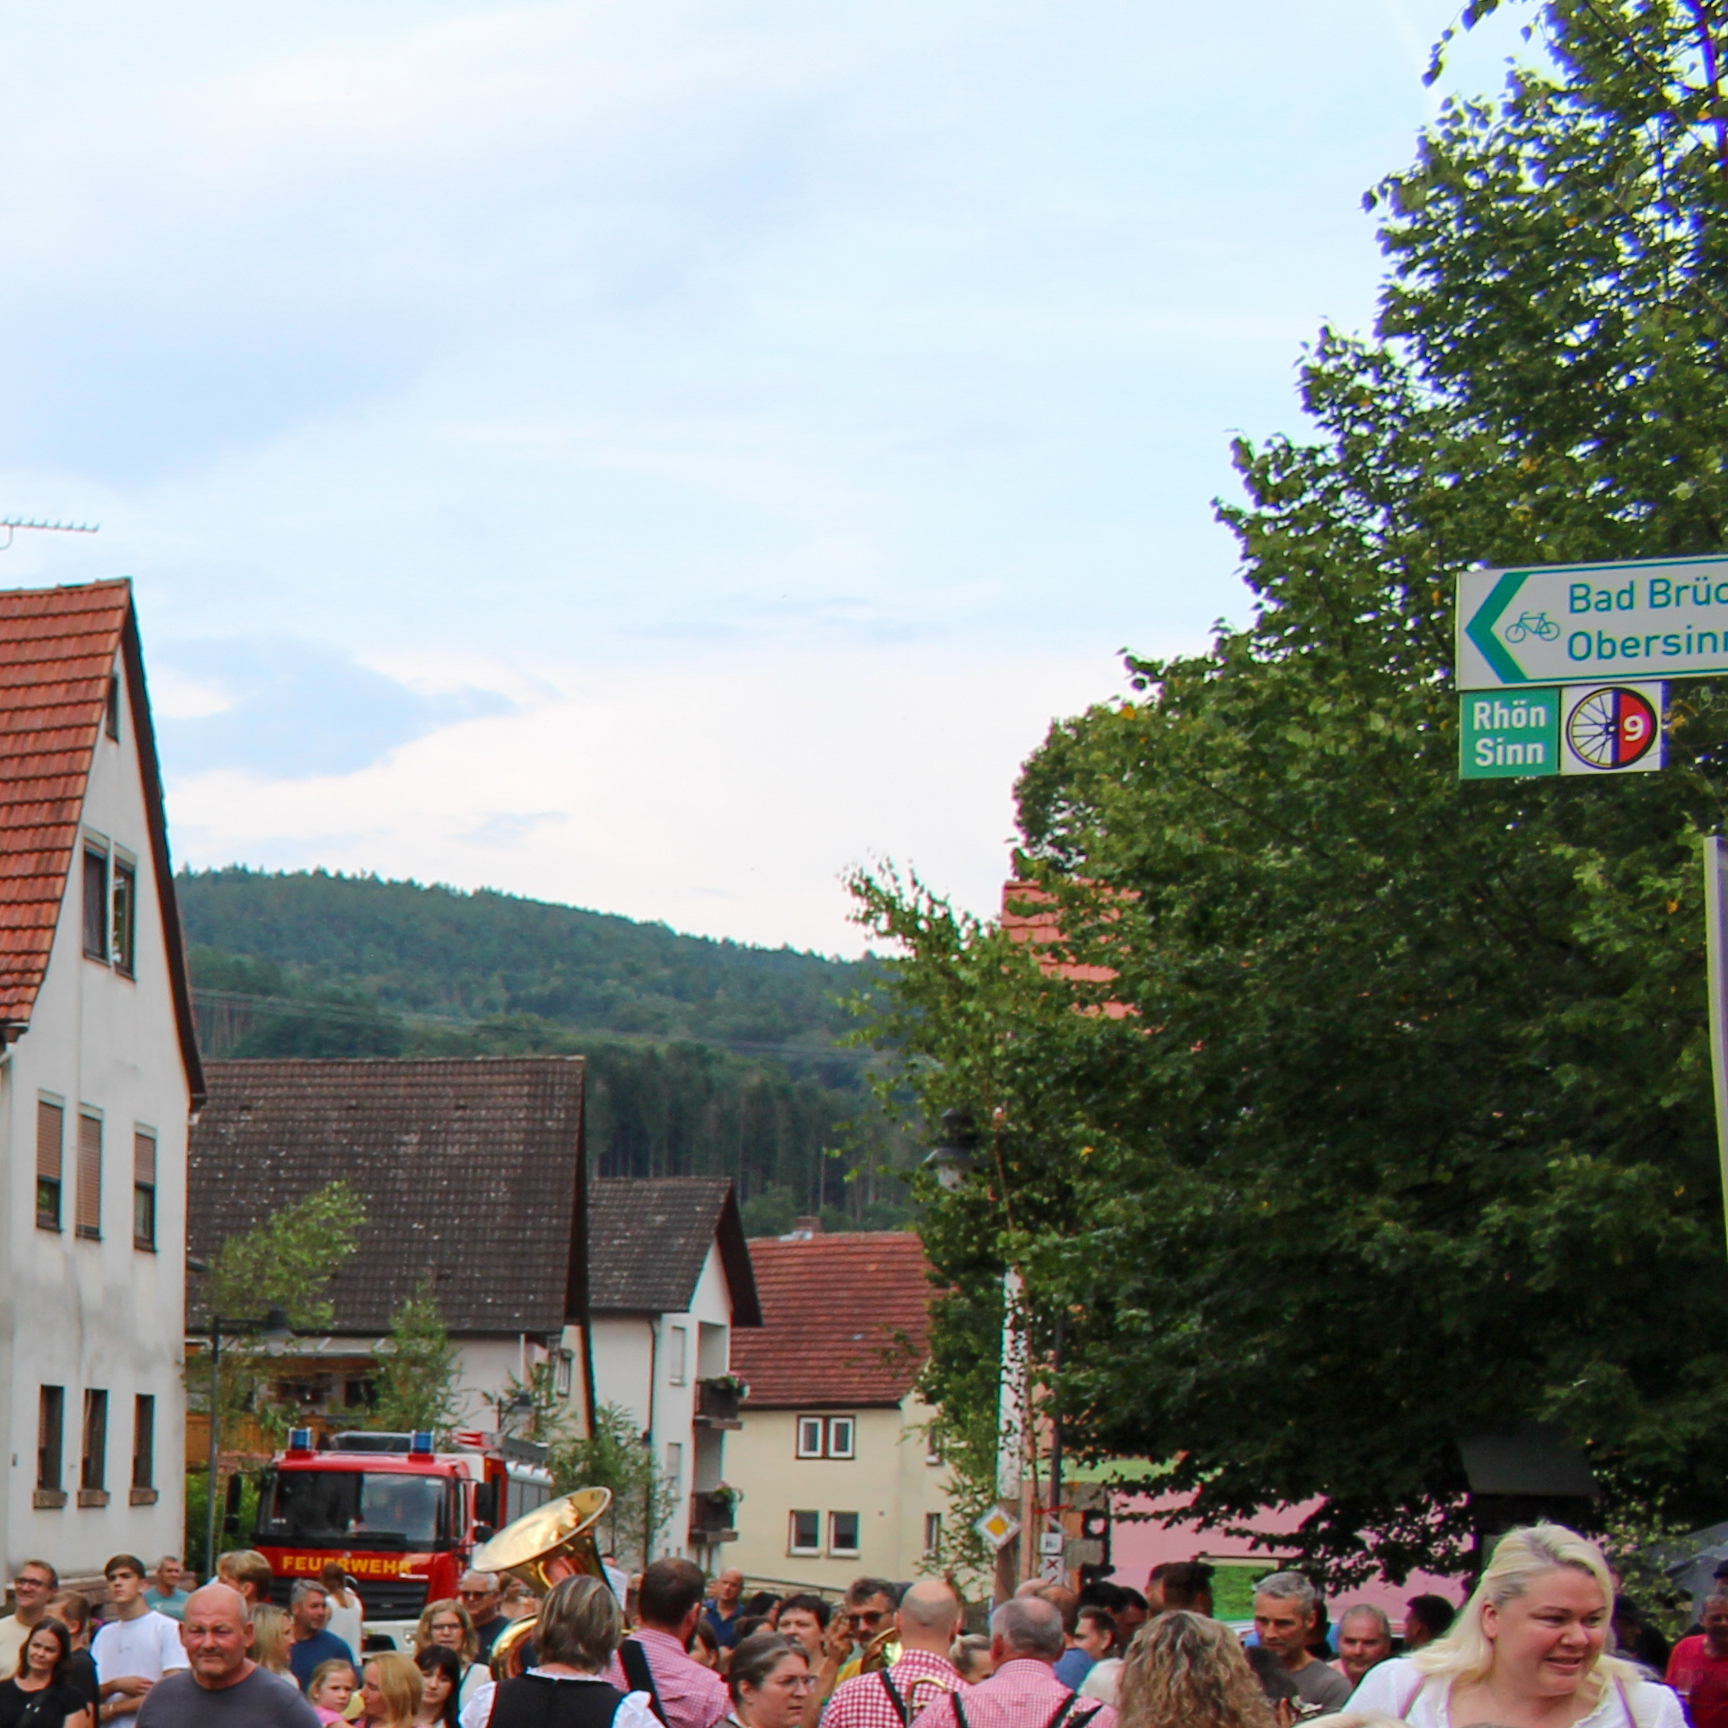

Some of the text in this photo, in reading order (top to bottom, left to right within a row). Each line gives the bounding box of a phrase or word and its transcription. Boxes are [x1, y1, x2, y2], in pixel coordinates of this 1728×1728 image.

[1568, 576, 1728, 614] Bad Brüc
[1567, 624, 1728, 662] Obersin
[1472, 700, 1546, 731] Rhön
[1623, 714, 1644, 742] 9
[1474, 738, 1545, 767] Sinn
